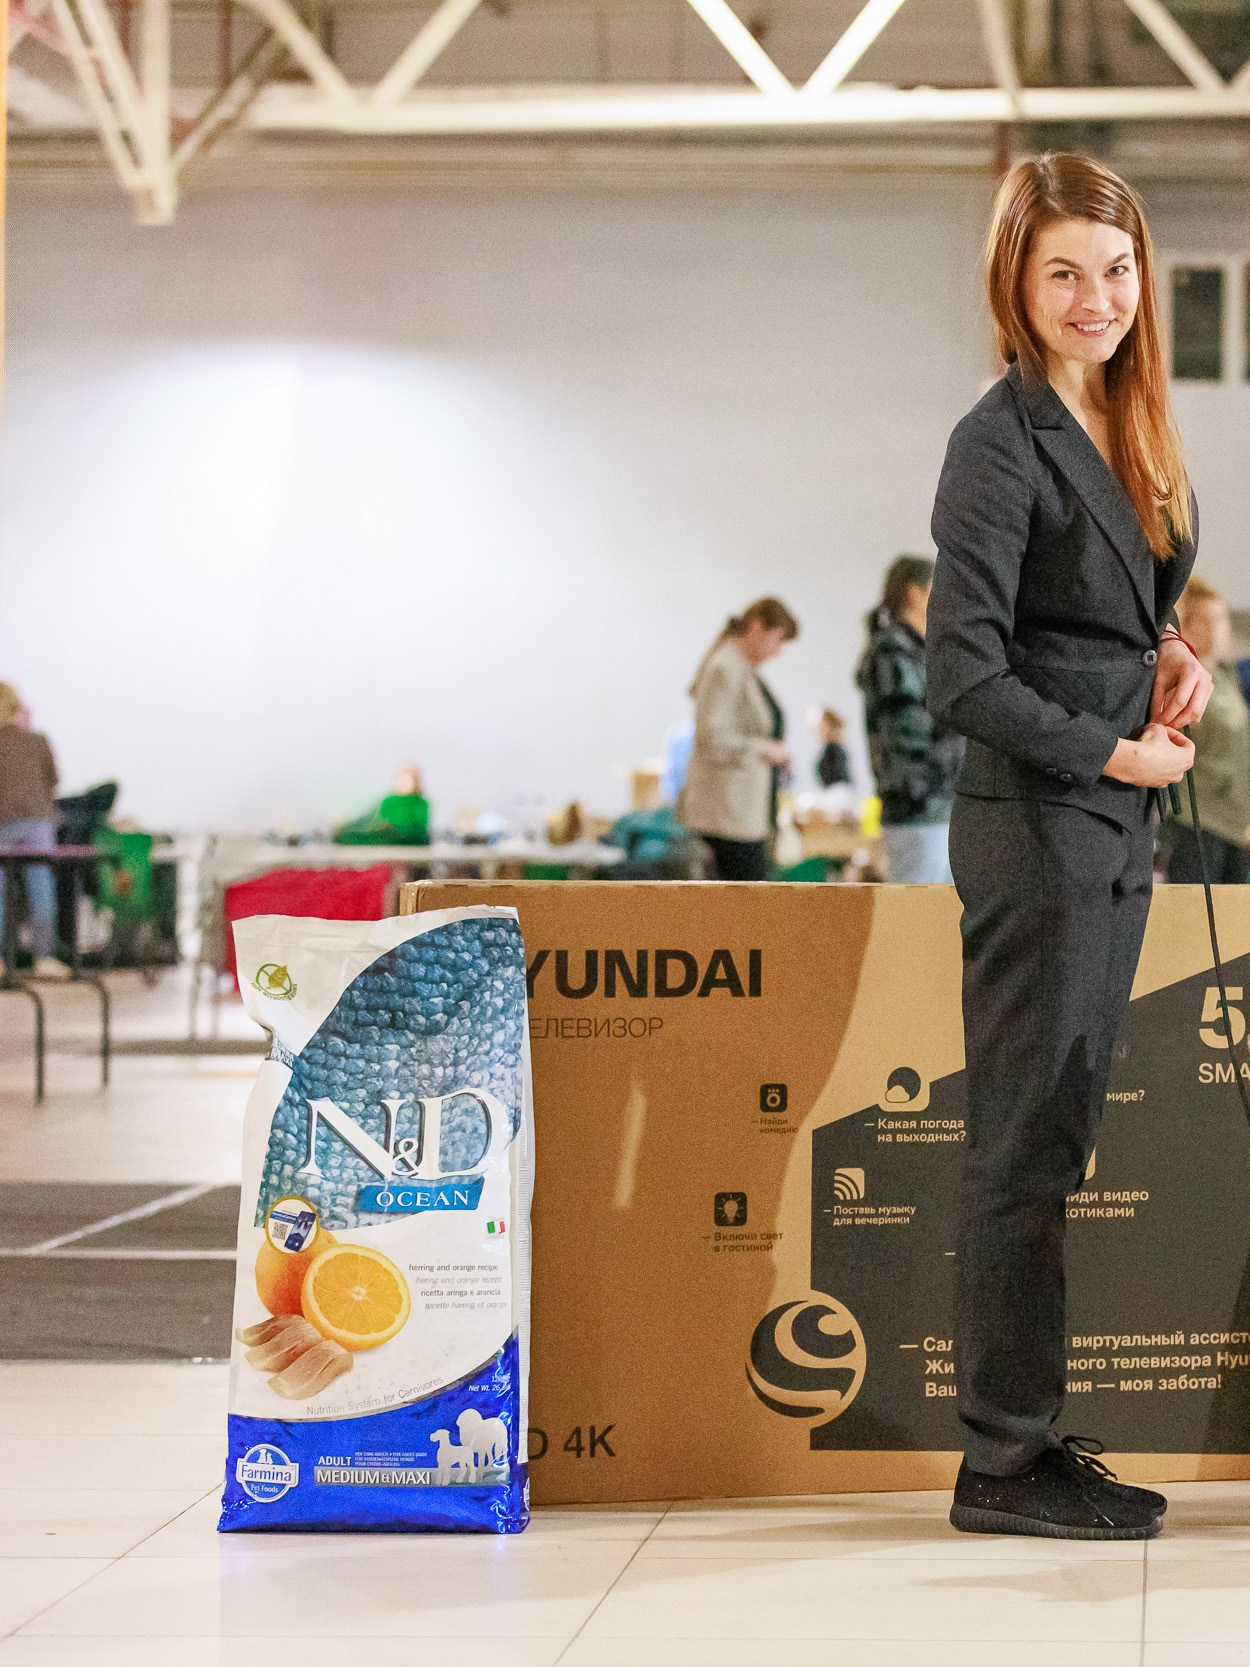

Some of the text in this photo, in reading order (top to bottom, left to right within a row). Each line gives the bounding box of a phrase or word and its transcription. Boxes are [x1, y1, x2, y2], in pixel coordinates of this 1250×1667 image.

[526, 949, 763, 1000] YUNDAI
[529, 1016, 664, 1040] ЕЛЕВИЗОР
[1106, 1089, 1146, 1104] мире?
[877, 1118, 917, 1130] Какая
[920, 1119, 965, 1130] погода
[298, 1087, 505, 1181] N&D
[877, 1130, 967, 1143] на выходных?
[376, 1189, 469, 1207] OCEAN
[1103, 1190, 1150, 1204] видео
[833, 1205, 876, 1215] Поставь
[878, 1205, 917, 1216] музыку
[833, 1216, 910, 1227] для вечеринки
[760, 1231, 784, 1241] свет
[723, 1241, 774, 1253] гостиной
[408, 1263, 498, 1273] herring and orange recipe
[420, 1289, 444, 1297] ricetta
[446, 1289, 468, 1298] aringa
[1071, 1330, 1185, 1351] виртуальный
[1066, 1356, 1107, 1371] ного
[1111, 1353, 1212, 1371] телевизора
[1119, 1378, 1154, 1392] моя
[1158, 1374, 1222, 1391] забота!
[306, 1376, 444, 1416] Nutrition System for Carnivores
[562, 1423, 616, 1458] 4K
[317, 1455, 352, 1467] ADULT
[241, 1464, 292, 1482] Farmina
